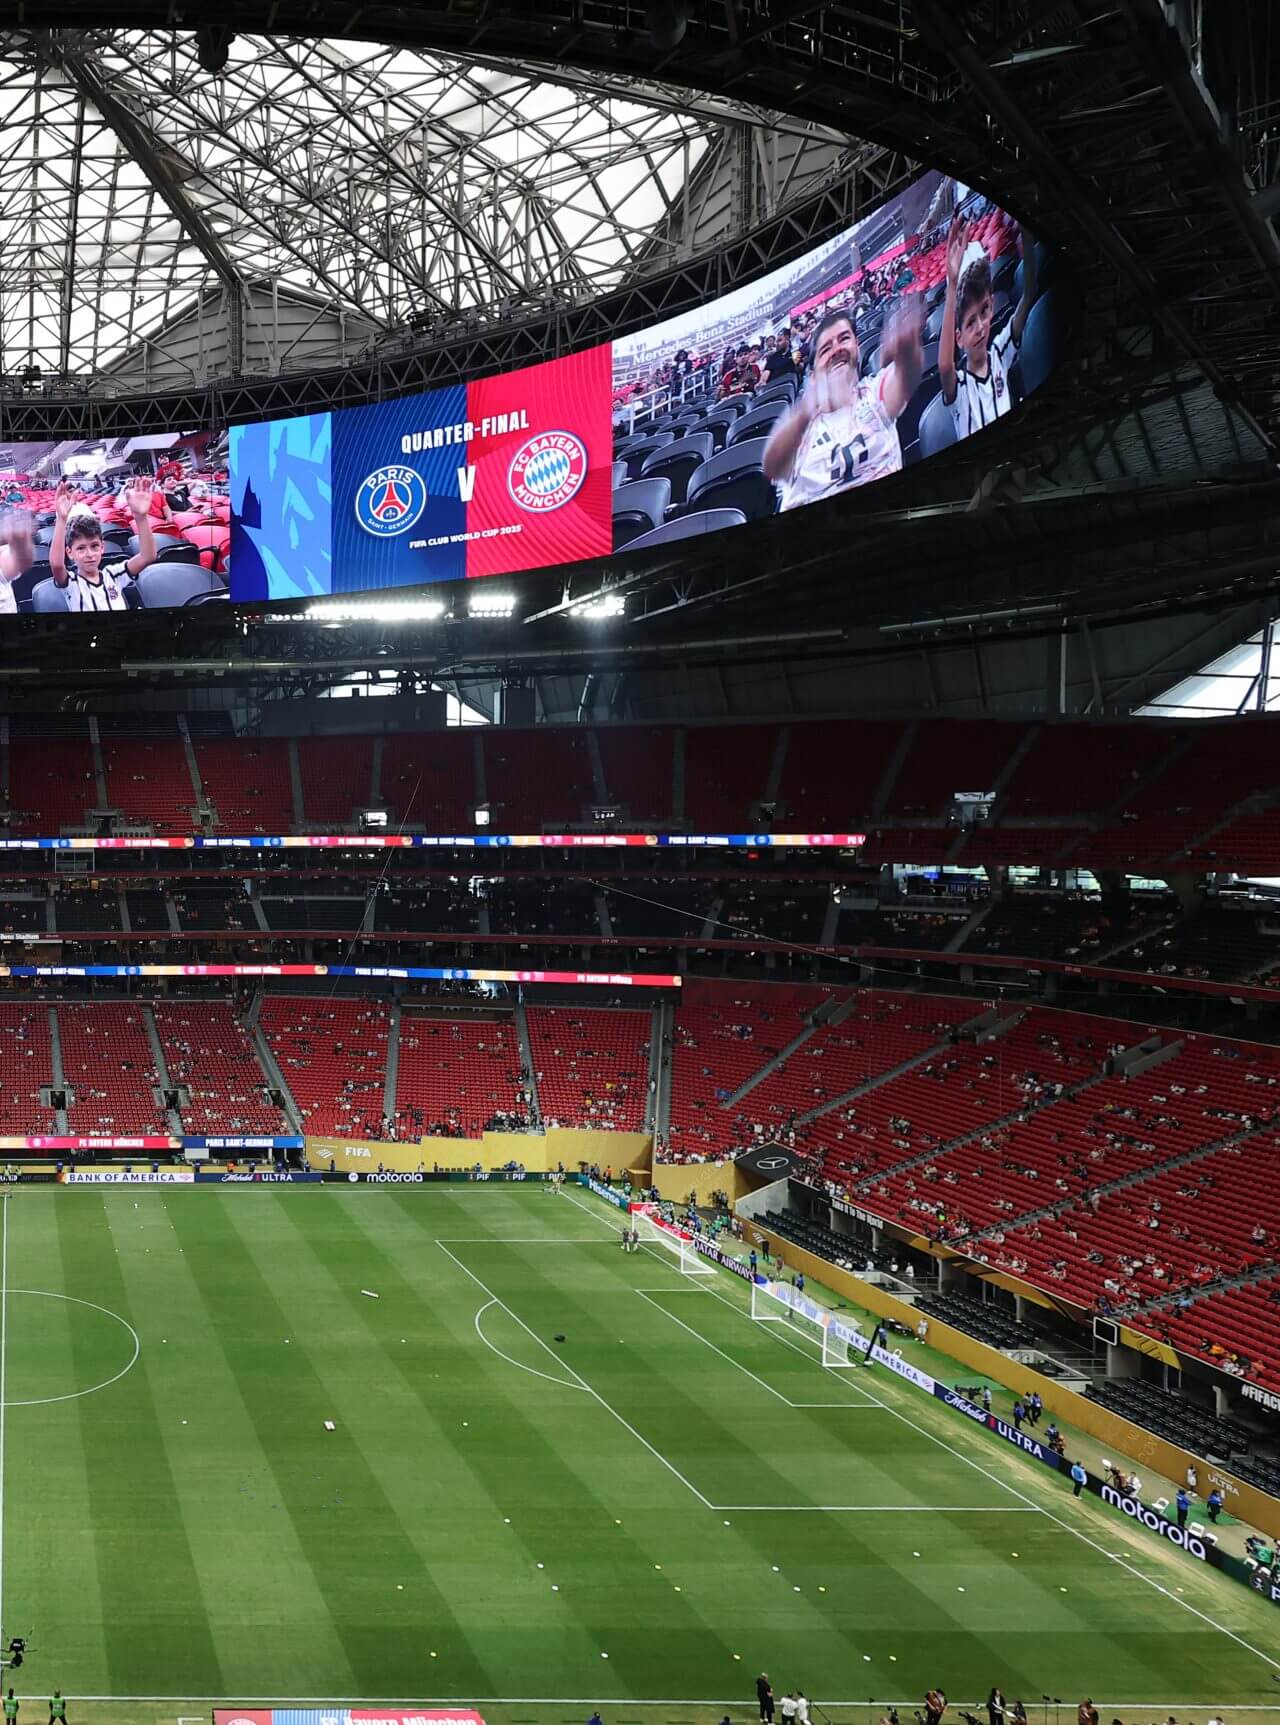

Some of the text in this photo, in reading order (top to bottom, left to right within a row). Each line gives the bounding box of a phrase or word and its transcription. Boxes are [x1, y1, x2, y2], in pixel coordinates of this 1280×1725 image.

[632, 302, 774, 366] Mercedes-Benz Stadium
[401, 409, 529, 454] QUARTER-FINAL
[514, 434, 581, 473] FC BAYERN
[367, 467, 415, 489] PARIS
[456, 464, 476, 503] V
[514, 472, 580, 508] MÜNCHEN
[409, 525, 522, 549] FIFA CLUB WORLD CUP 2025
[345, 1147, 371, 1158] FIFA
[69, 1174, 175, 1183] BANK OF AMERICA
[262, 1173, 293, 1182] ULTRA
[367, 1172, 423, 1183] motorola
[588, 1179, 621, 1207] Hisense
[694, 1240, 756, 1282] QATAR AIRWAYS
[875, 1350, 918, 1382] AMERICA
[998, 1421, 1044, 1459] ULTRA
[1208, 1474, 1239, 1497] ULTRA
[1101, 1485, 1206, 1560] motorola
